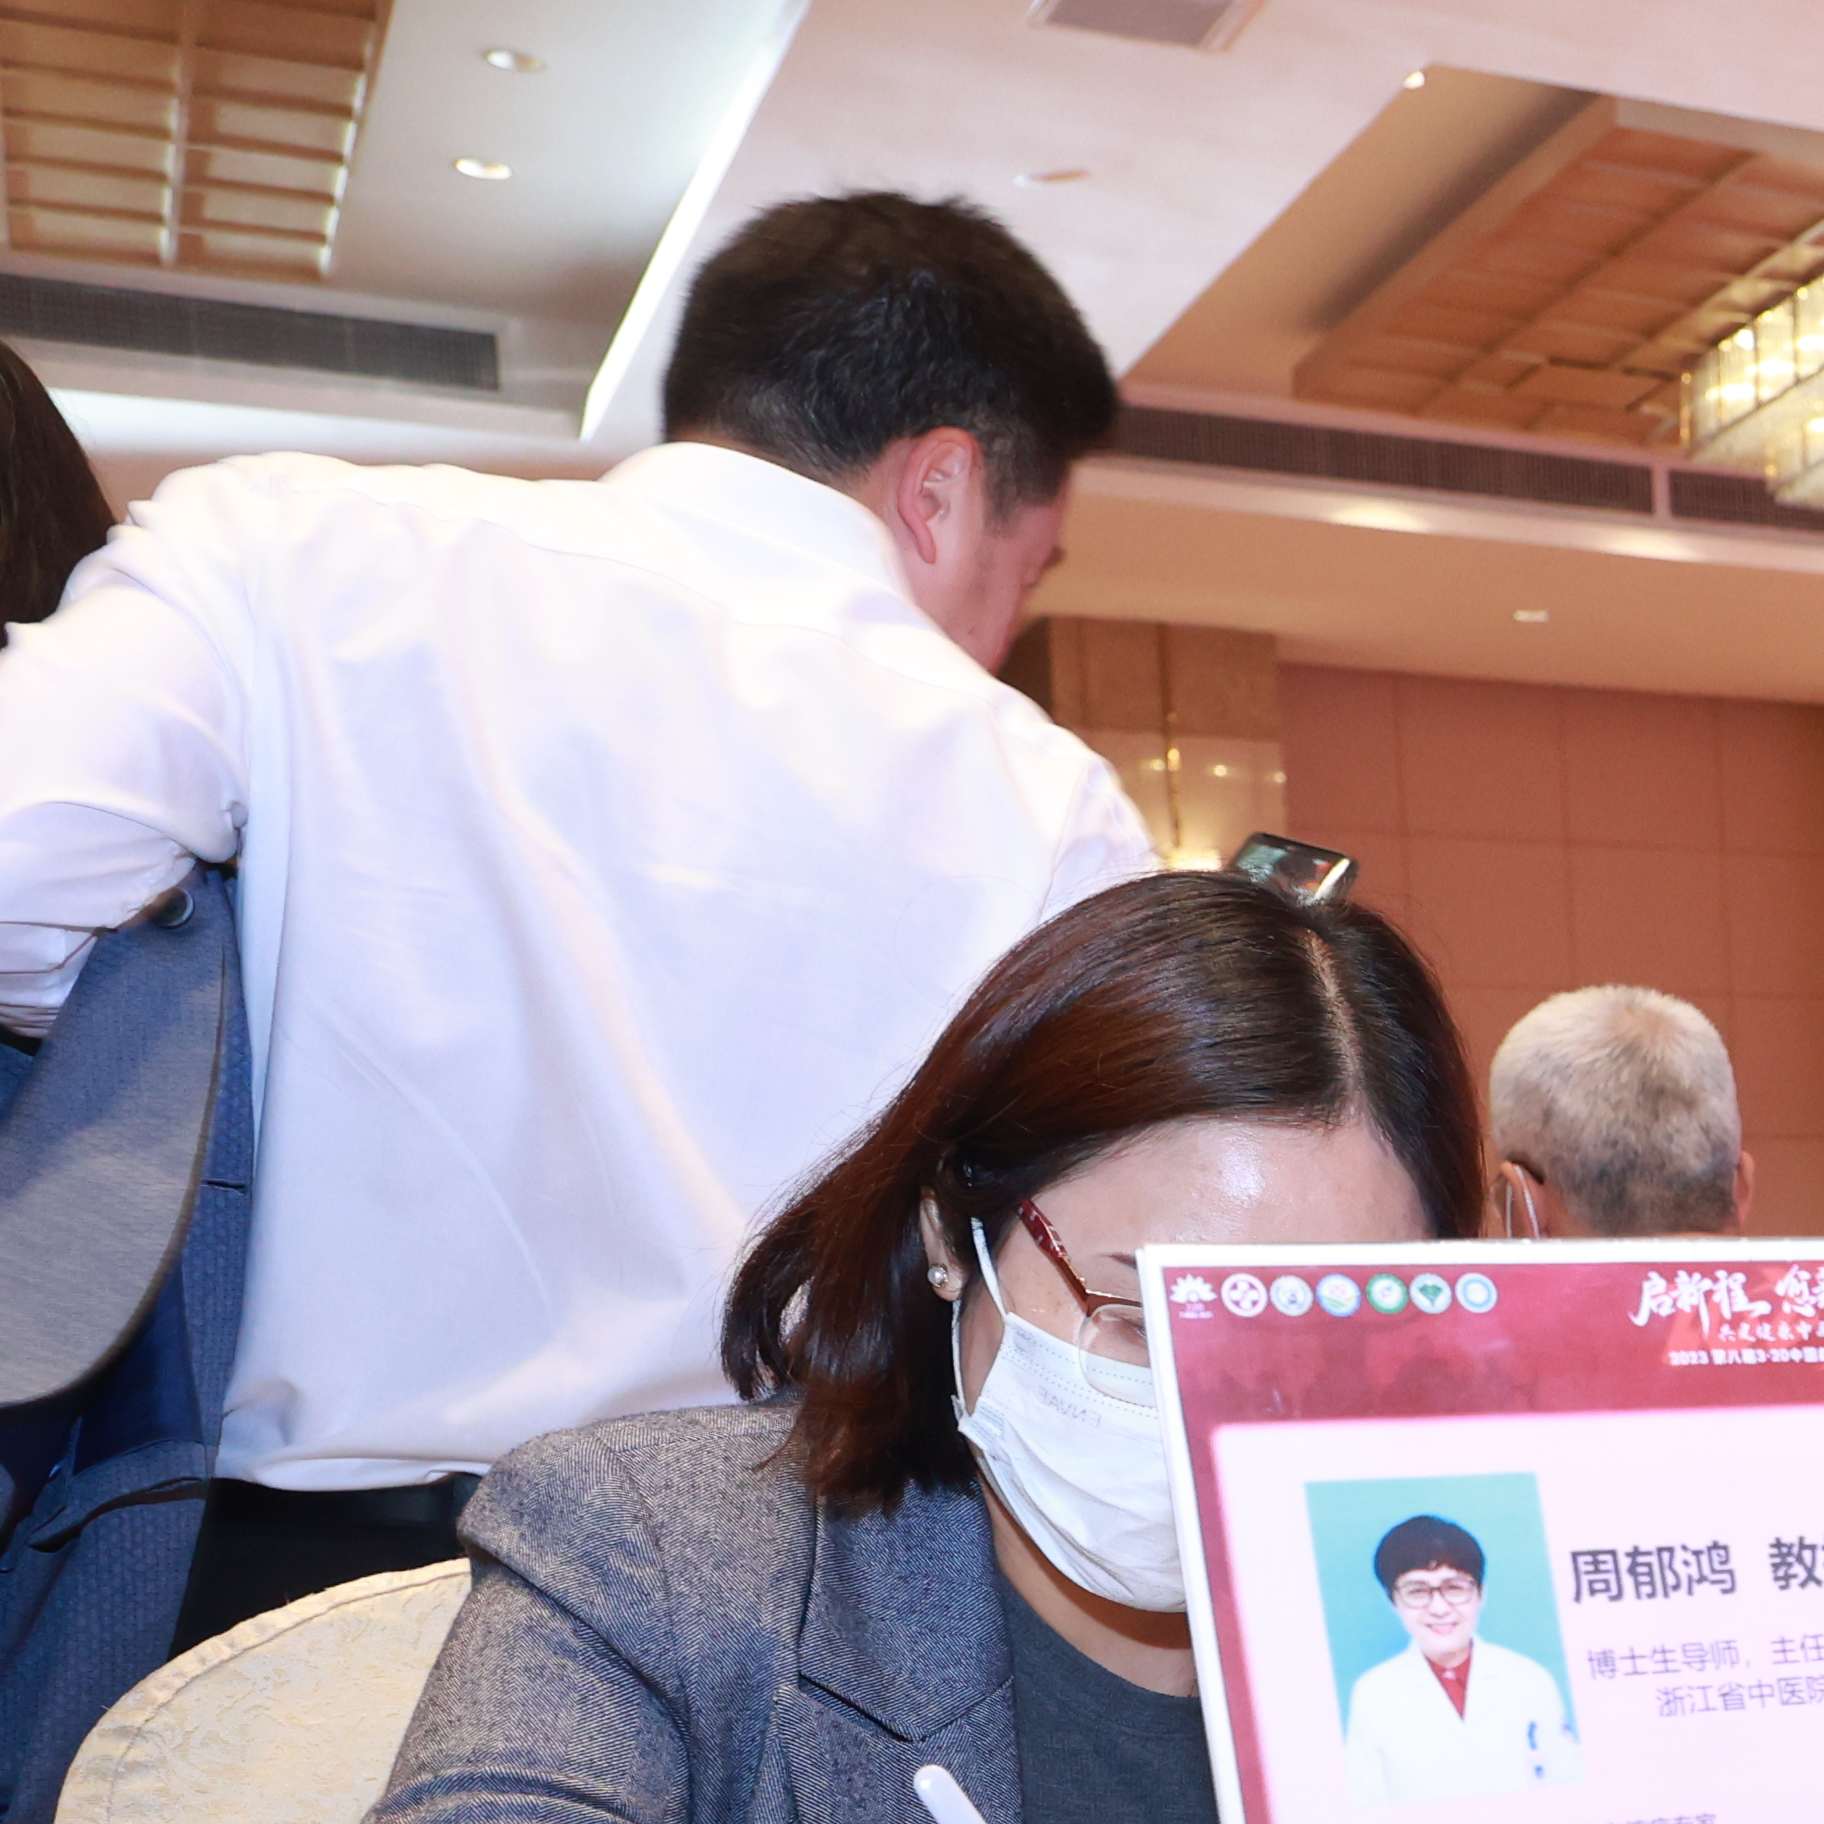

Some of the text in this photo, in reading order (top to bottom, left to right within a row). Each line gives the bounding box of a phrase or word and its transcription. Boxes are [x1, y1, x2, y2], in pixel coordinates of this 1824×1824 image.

[1628, 1270, 1772, 1339] 启新程
[1571, 1540, 1736, 1602] 周郁鸿
